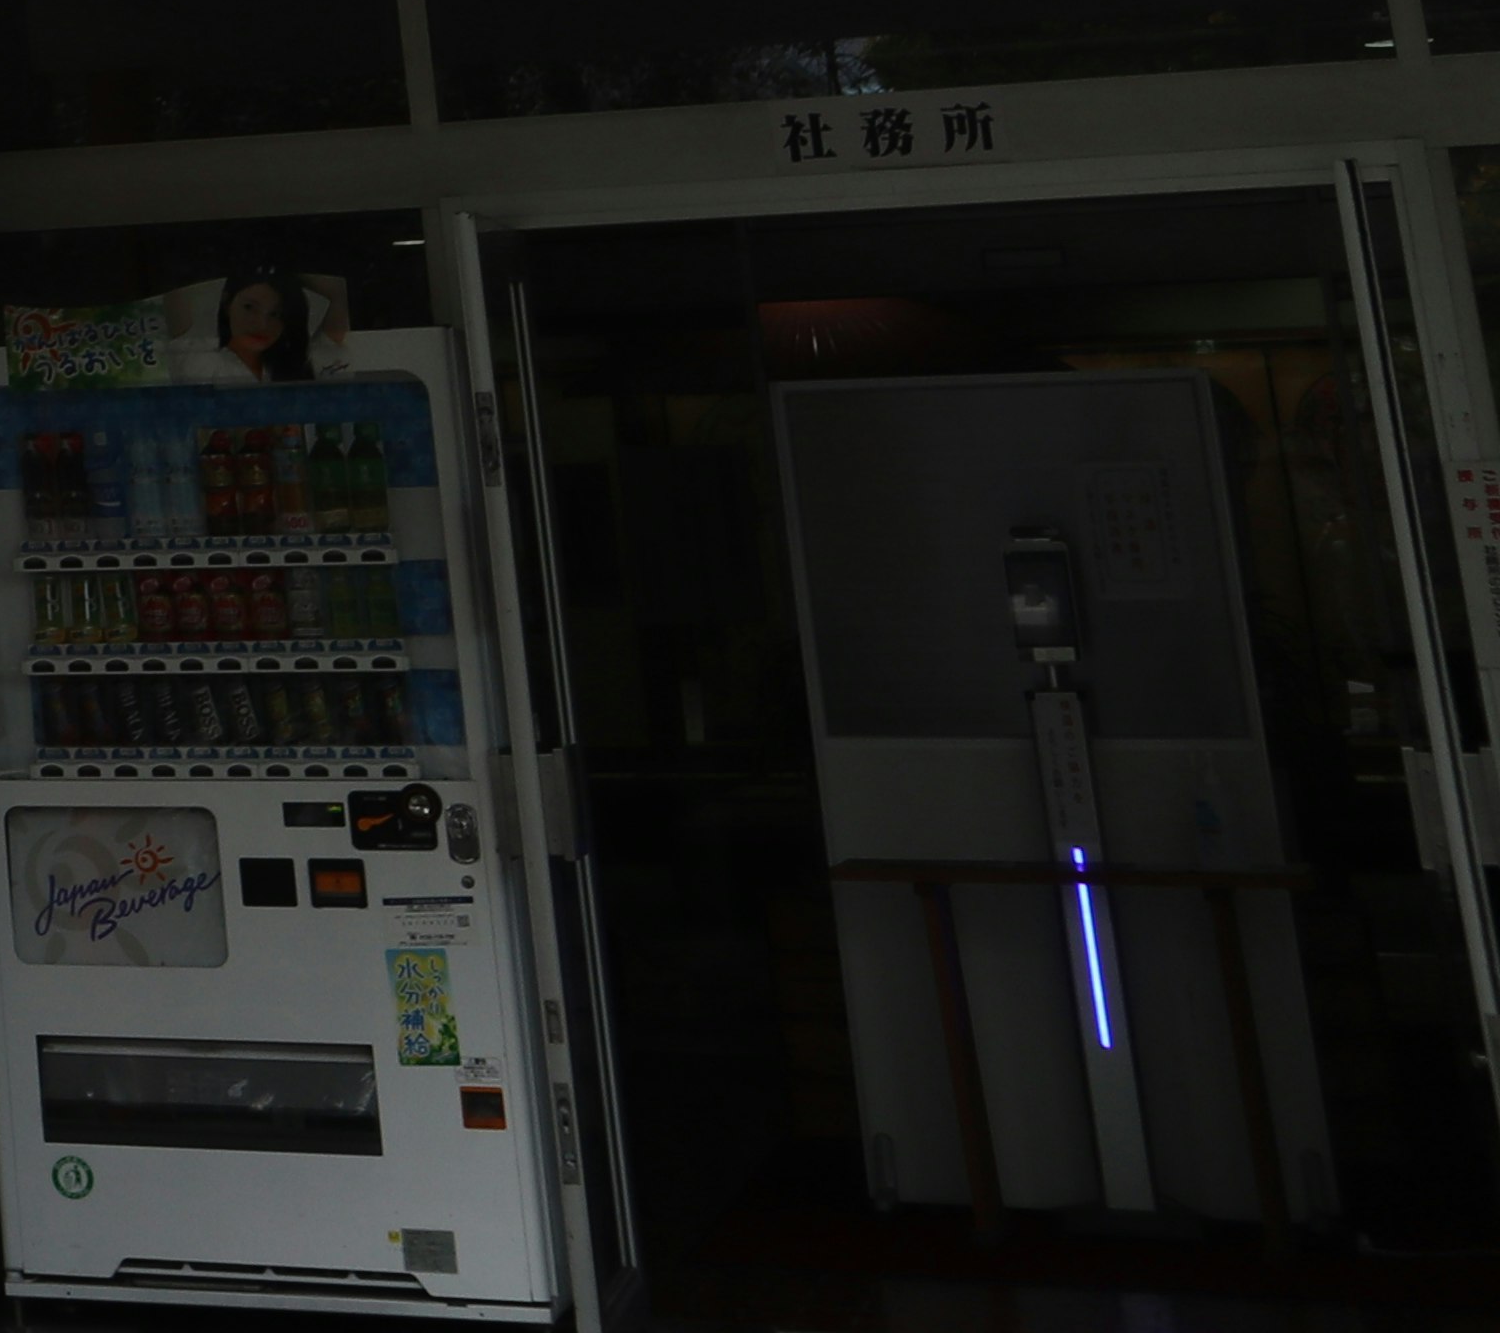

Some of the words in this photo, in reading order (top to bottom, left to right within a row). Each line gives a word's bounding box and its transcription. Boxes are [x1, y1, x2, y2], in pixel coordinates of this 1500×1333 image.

[780, 102, 994, 161] 社務所
[35, 337, 159, 383] うるおいを
[34, 868, 135, 937] Japan
[78, 870, 222, 942] Beverage
[396, 958, 431, 1057] 水分補給
